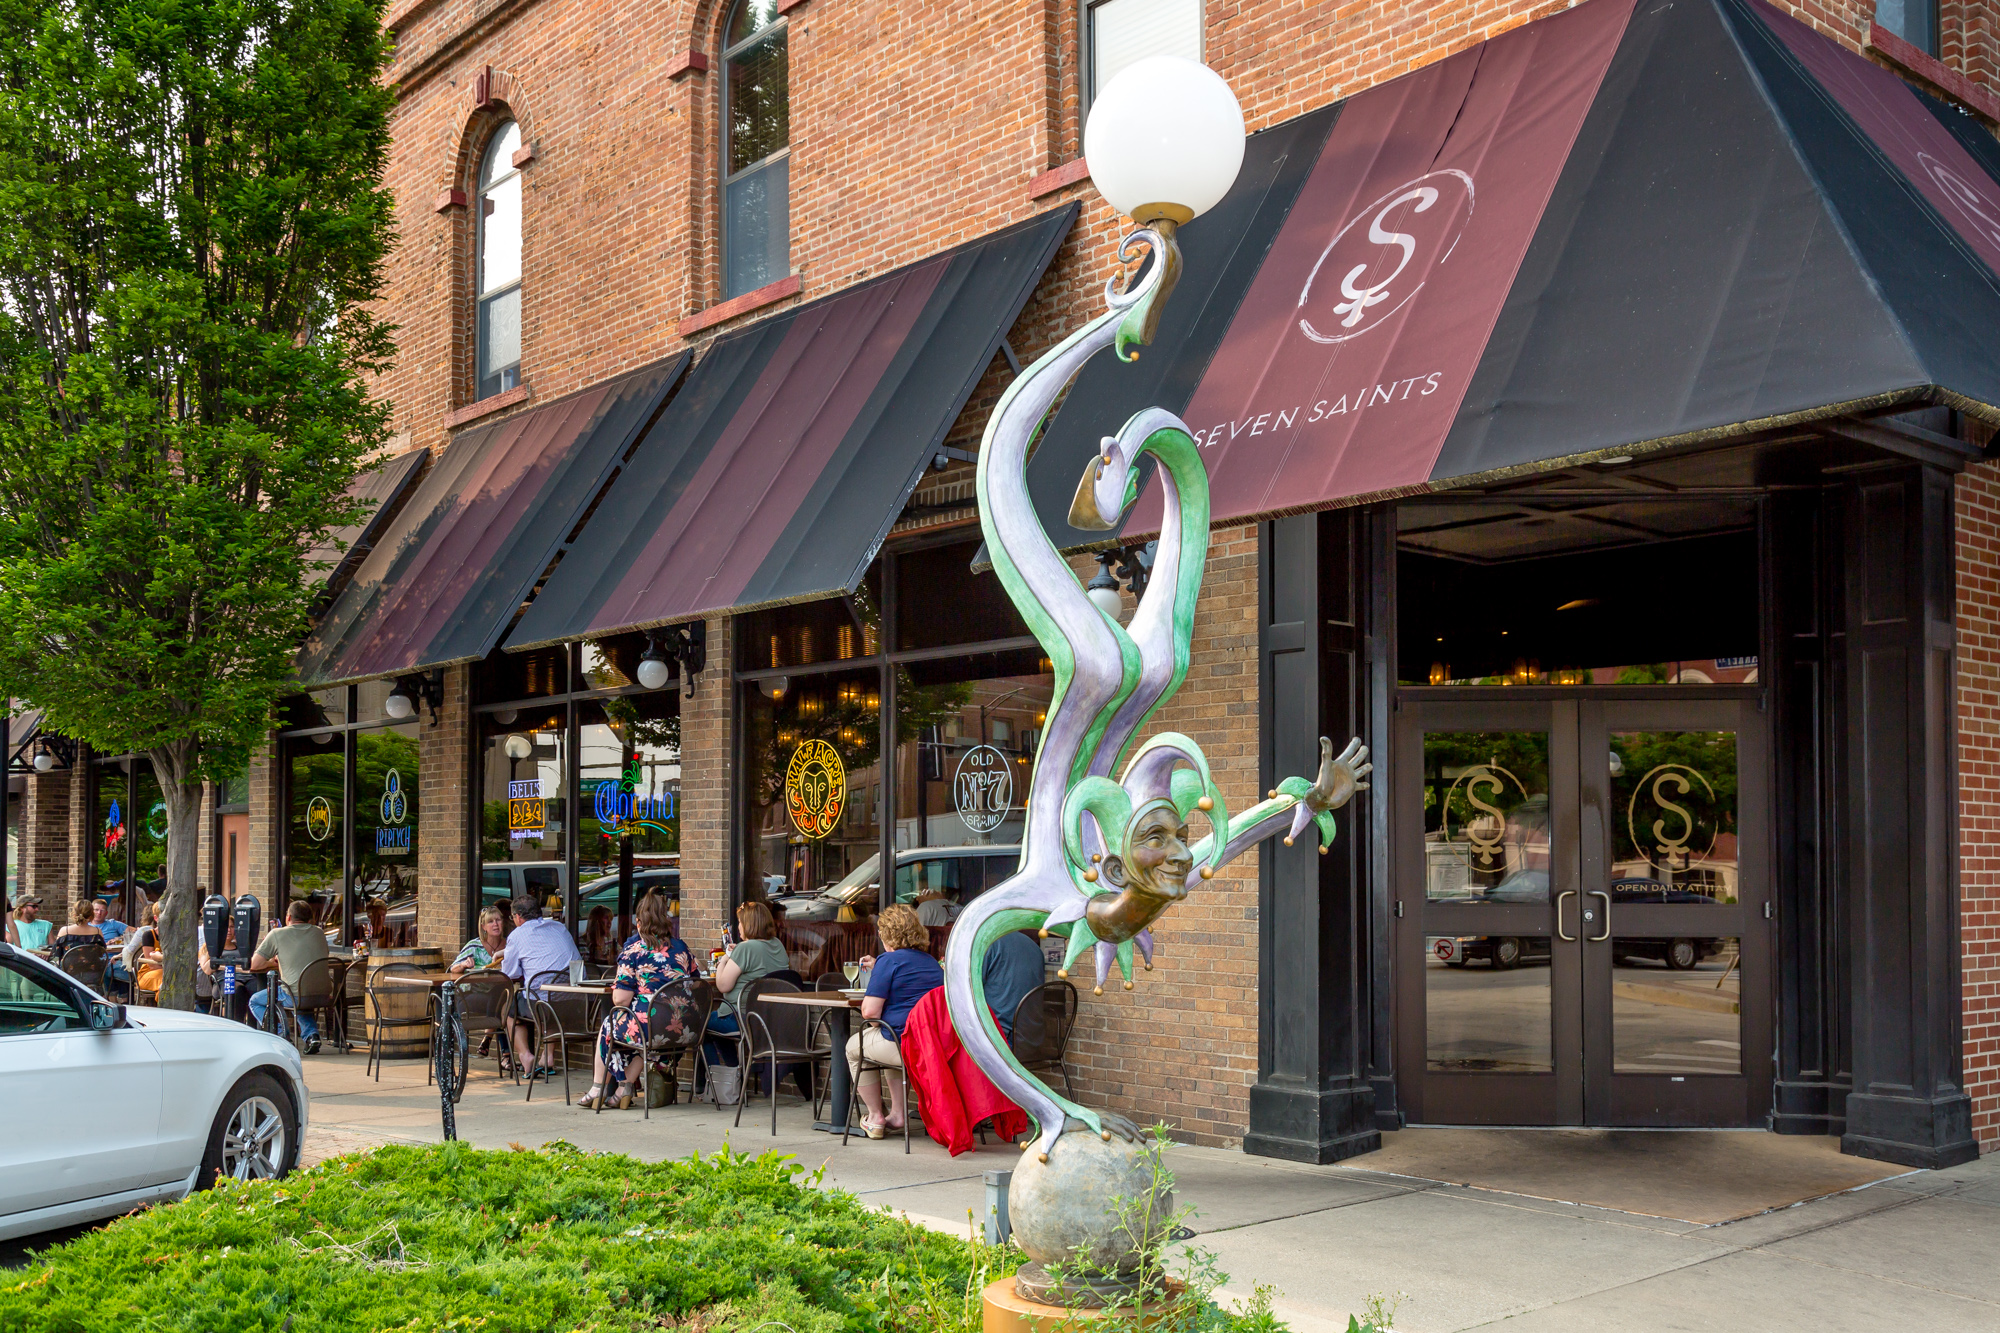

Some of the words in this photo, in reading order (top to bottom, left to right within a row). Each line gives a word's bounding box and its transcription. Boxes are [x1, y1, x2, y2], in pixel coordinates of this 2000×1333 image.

[1193, 406, 1301, 448] SEVEN
[1307, 371, 1443, 423] SAINTS
[788, 743, 814, 789] HALF
[814, 743, 843, 789] ACRE
[970, 753, 994, 766] OLD
[511, 783, 542, 798] BELL'S
[594, 780, 675, 829] Corona
[376, 826, 411, 853] TRIPTYCH
[1616, 884, 1648, 892] OPEN
[1651, 884, 1685, 892] DAILY
[1687, 884, 1702, 892] AT
